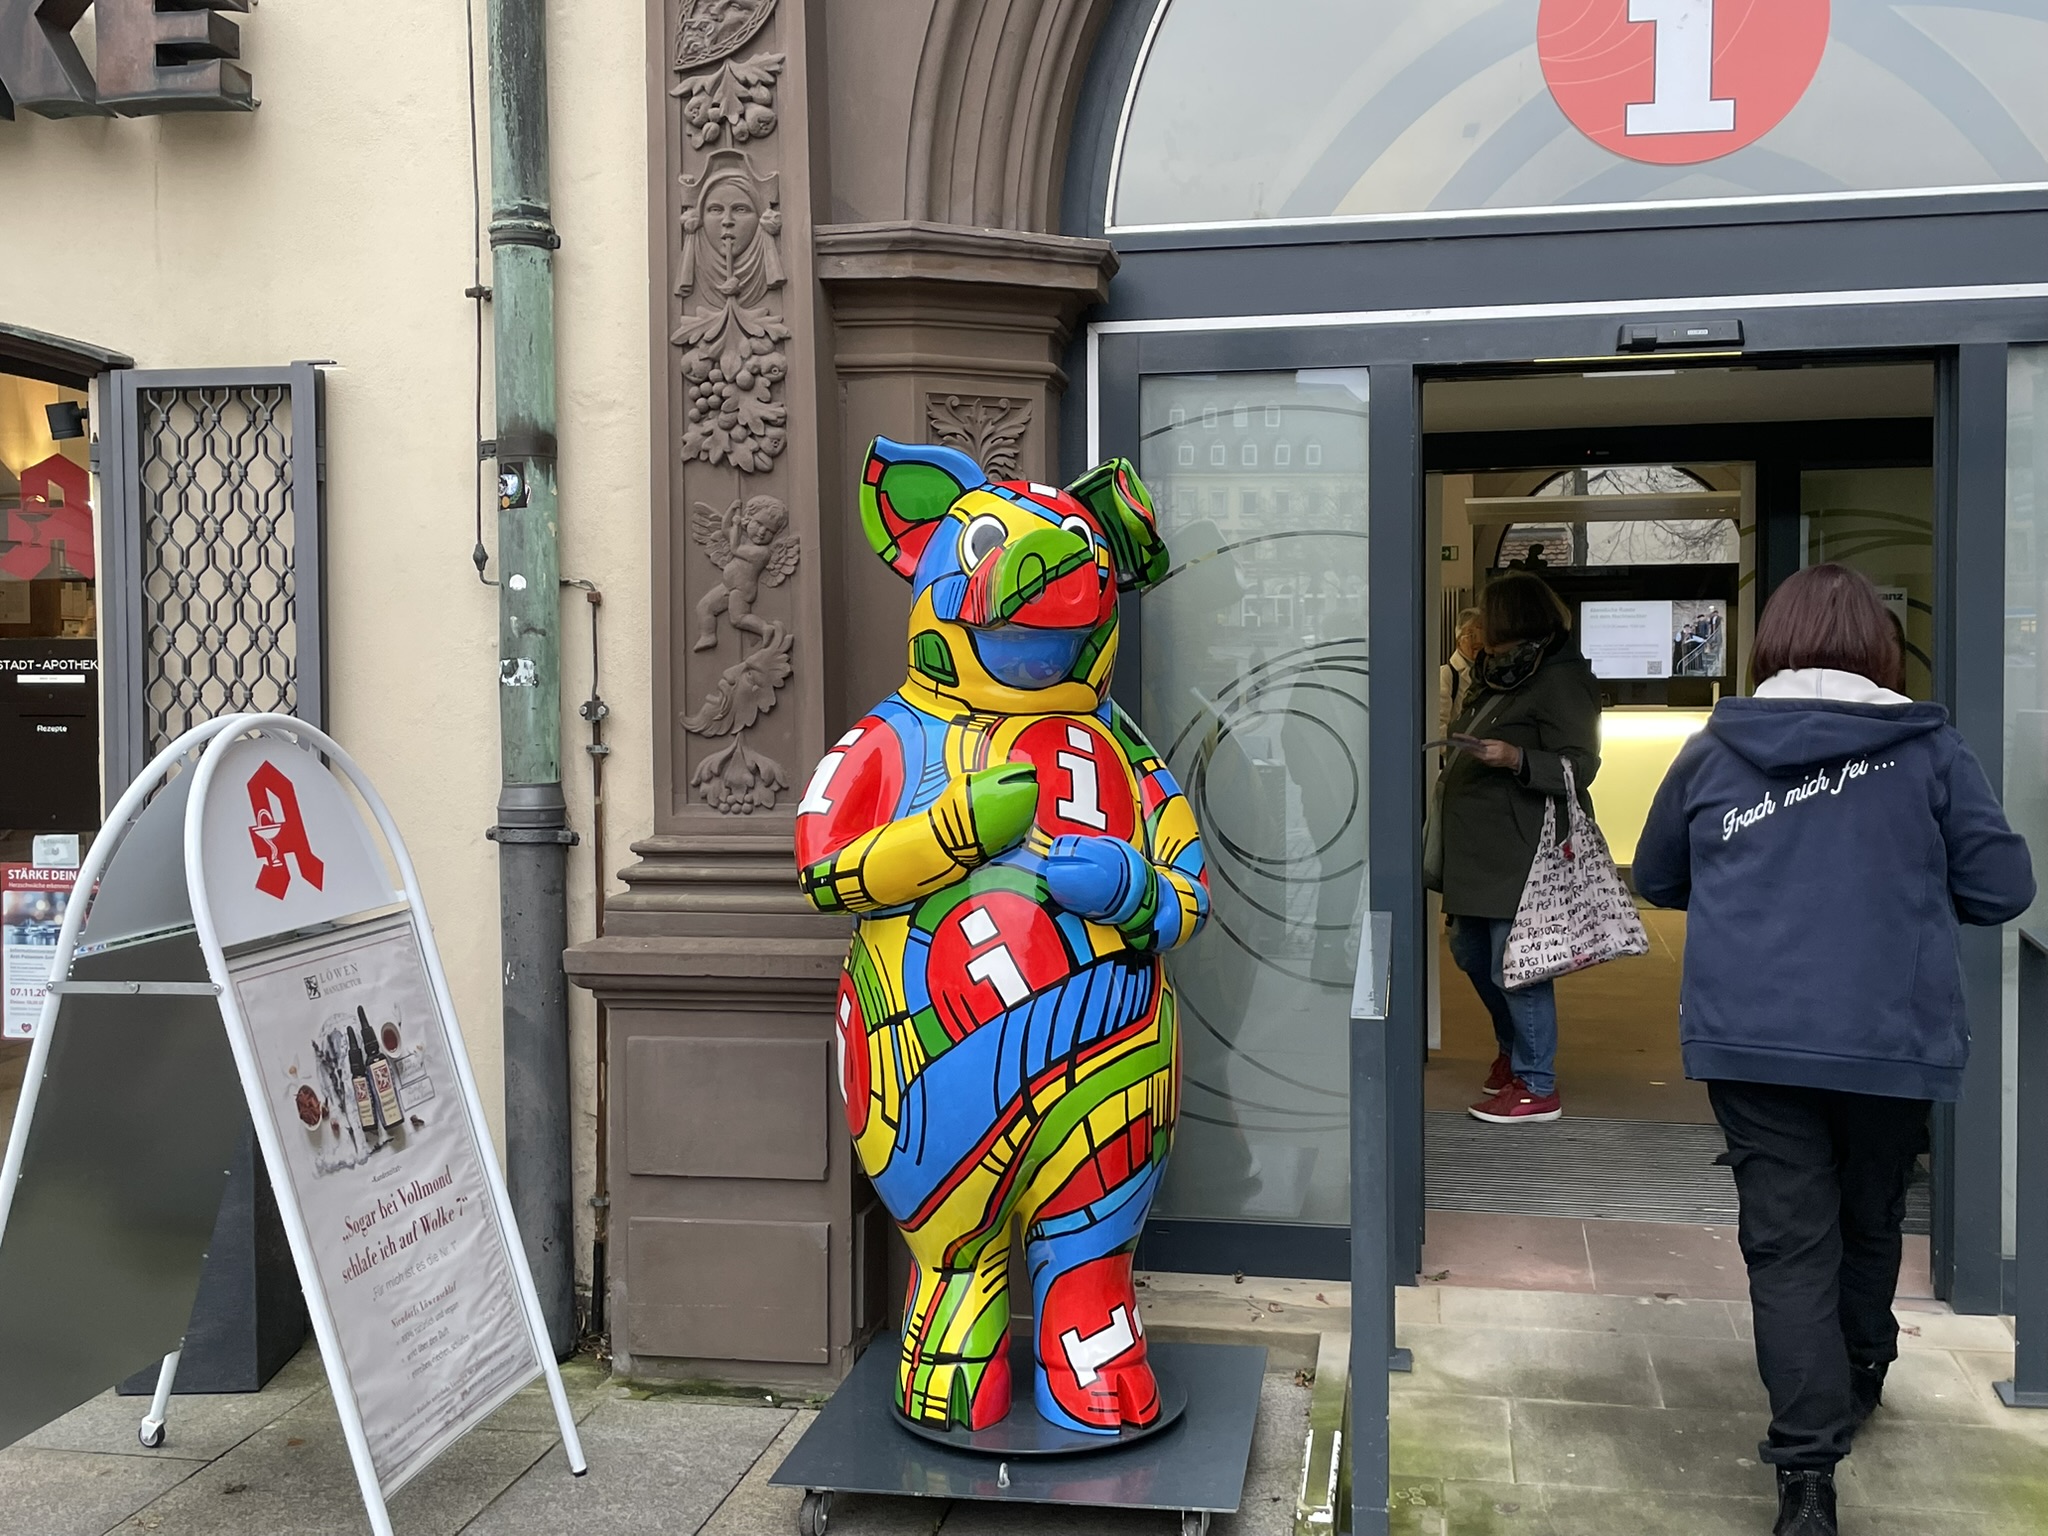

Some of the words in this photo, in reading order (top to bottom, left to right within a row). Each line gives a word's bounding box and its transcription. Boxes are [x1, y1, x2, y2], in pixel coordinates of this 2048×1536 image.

[37, 725, 67, 733] Rezepte
[1056, 724, 1108, 832] i
[1783, 768, 1830, 807] mich
[8, 868, 49, 880] STÄRKE
[319, 963, 359, 983] LÖWEN
[377, 1192, 399, 1219] bei
[397, 1164, 453, 1208] Vollmond
[341, 1247, 379, 1284] schlafe
[378, 1235, 397, 1261] ich
[398, 1220, 418, 1250] auf
[419, 1206, 455, 1236] Wolke
